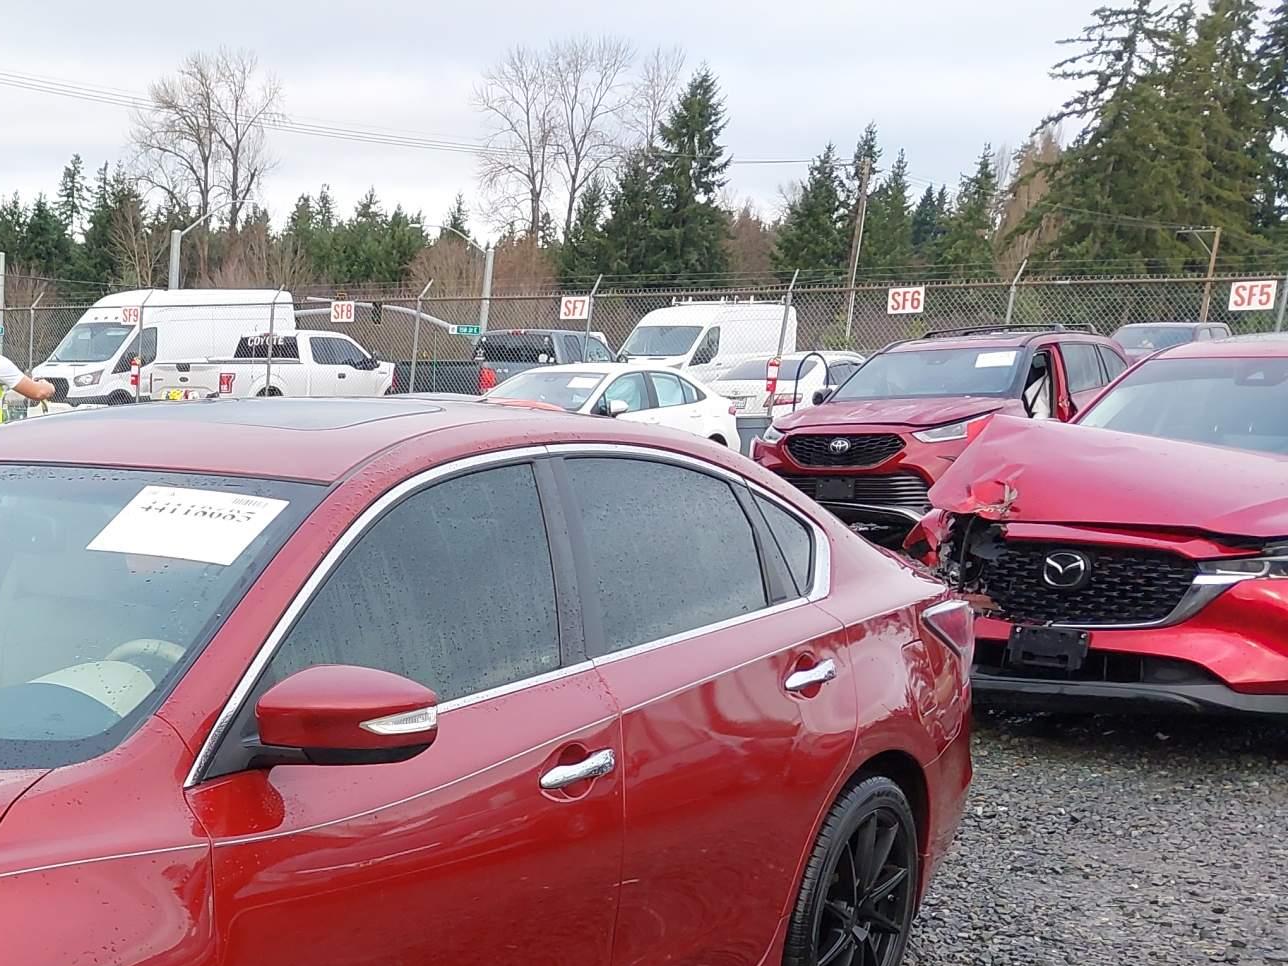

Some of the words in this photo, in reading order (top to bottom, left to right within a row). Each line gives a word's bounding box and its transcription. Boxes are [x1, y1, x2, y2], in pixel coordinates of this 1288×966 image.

[891, 290, 921, 311] SF6
[1233, 284, 1272, 307] SF5
[122, 308, 138, 323] SF9
[333, 303, 352, 320] SF8
[563, 299, 585, 317] SF7
